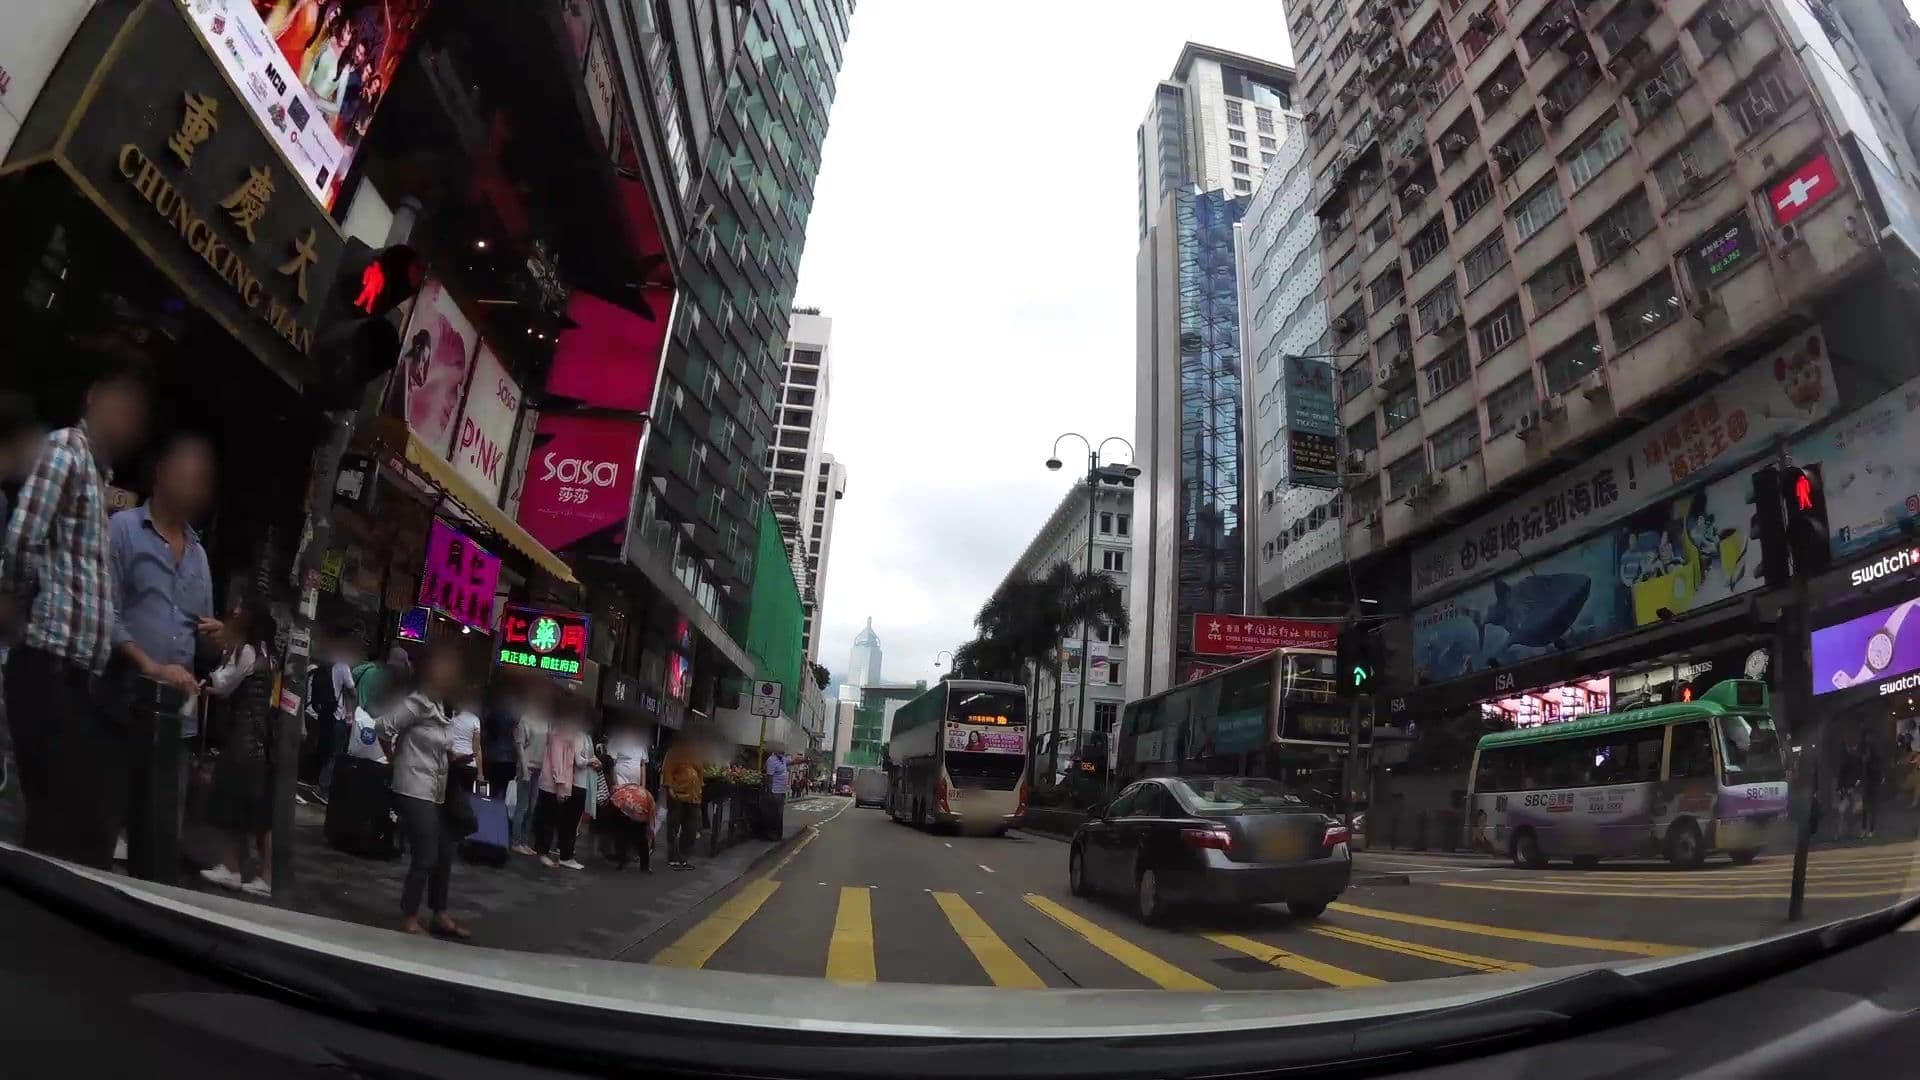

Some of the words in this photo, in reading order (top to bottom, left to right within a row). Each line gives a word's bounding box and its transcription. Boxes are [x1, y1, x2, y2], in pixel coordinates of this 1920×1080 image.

[265, 62, 287, 96] MCB
[118, 143, 261, 308] CHUNGKING
[558, 486, 589, 504] 莎莎
[1851, 549, 1910, 587] swatch
[1495, 672, 1514, 690] ISA
[1879, 671, 1920, 696] swatch
[1391, 697, 1406, 712] ISA
[1524, 793, 1549, 807] SBC
